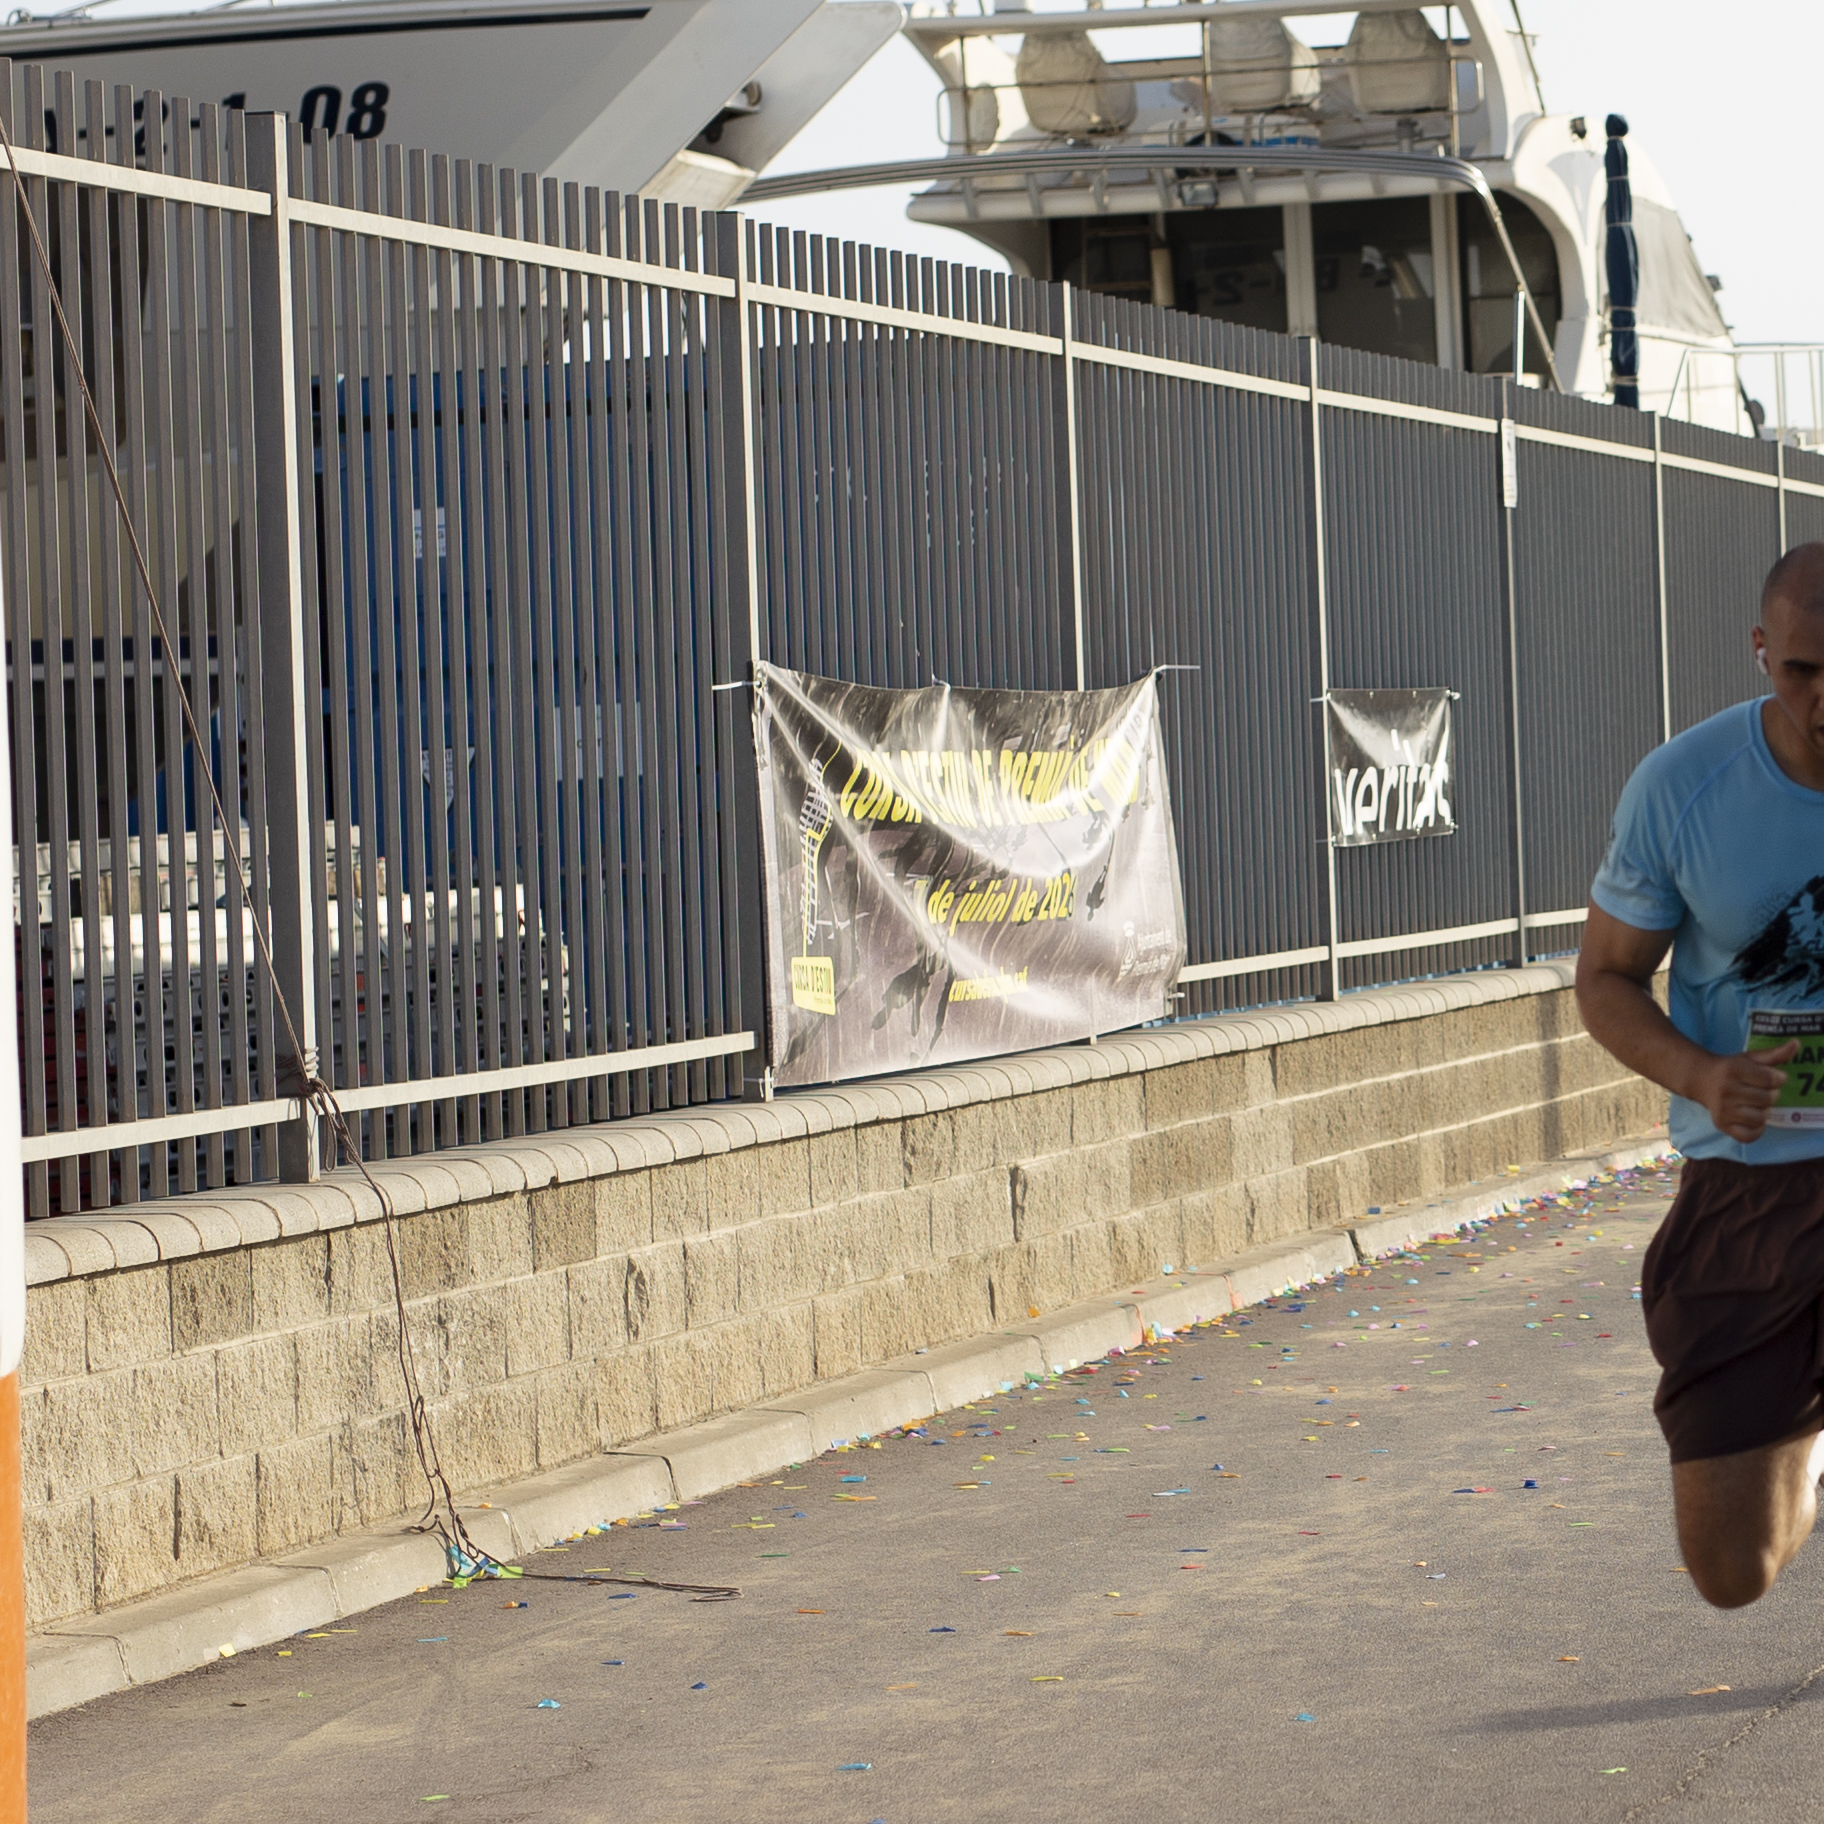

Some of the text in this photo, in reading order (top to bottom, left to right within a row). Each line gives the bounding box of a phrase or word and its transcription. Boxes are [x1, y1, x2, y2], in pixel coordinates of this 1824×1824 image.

[928, 878, 955, 925] de
[949, 878, 1018, 937] juliol
[1011, 877, 1039, 923] de
